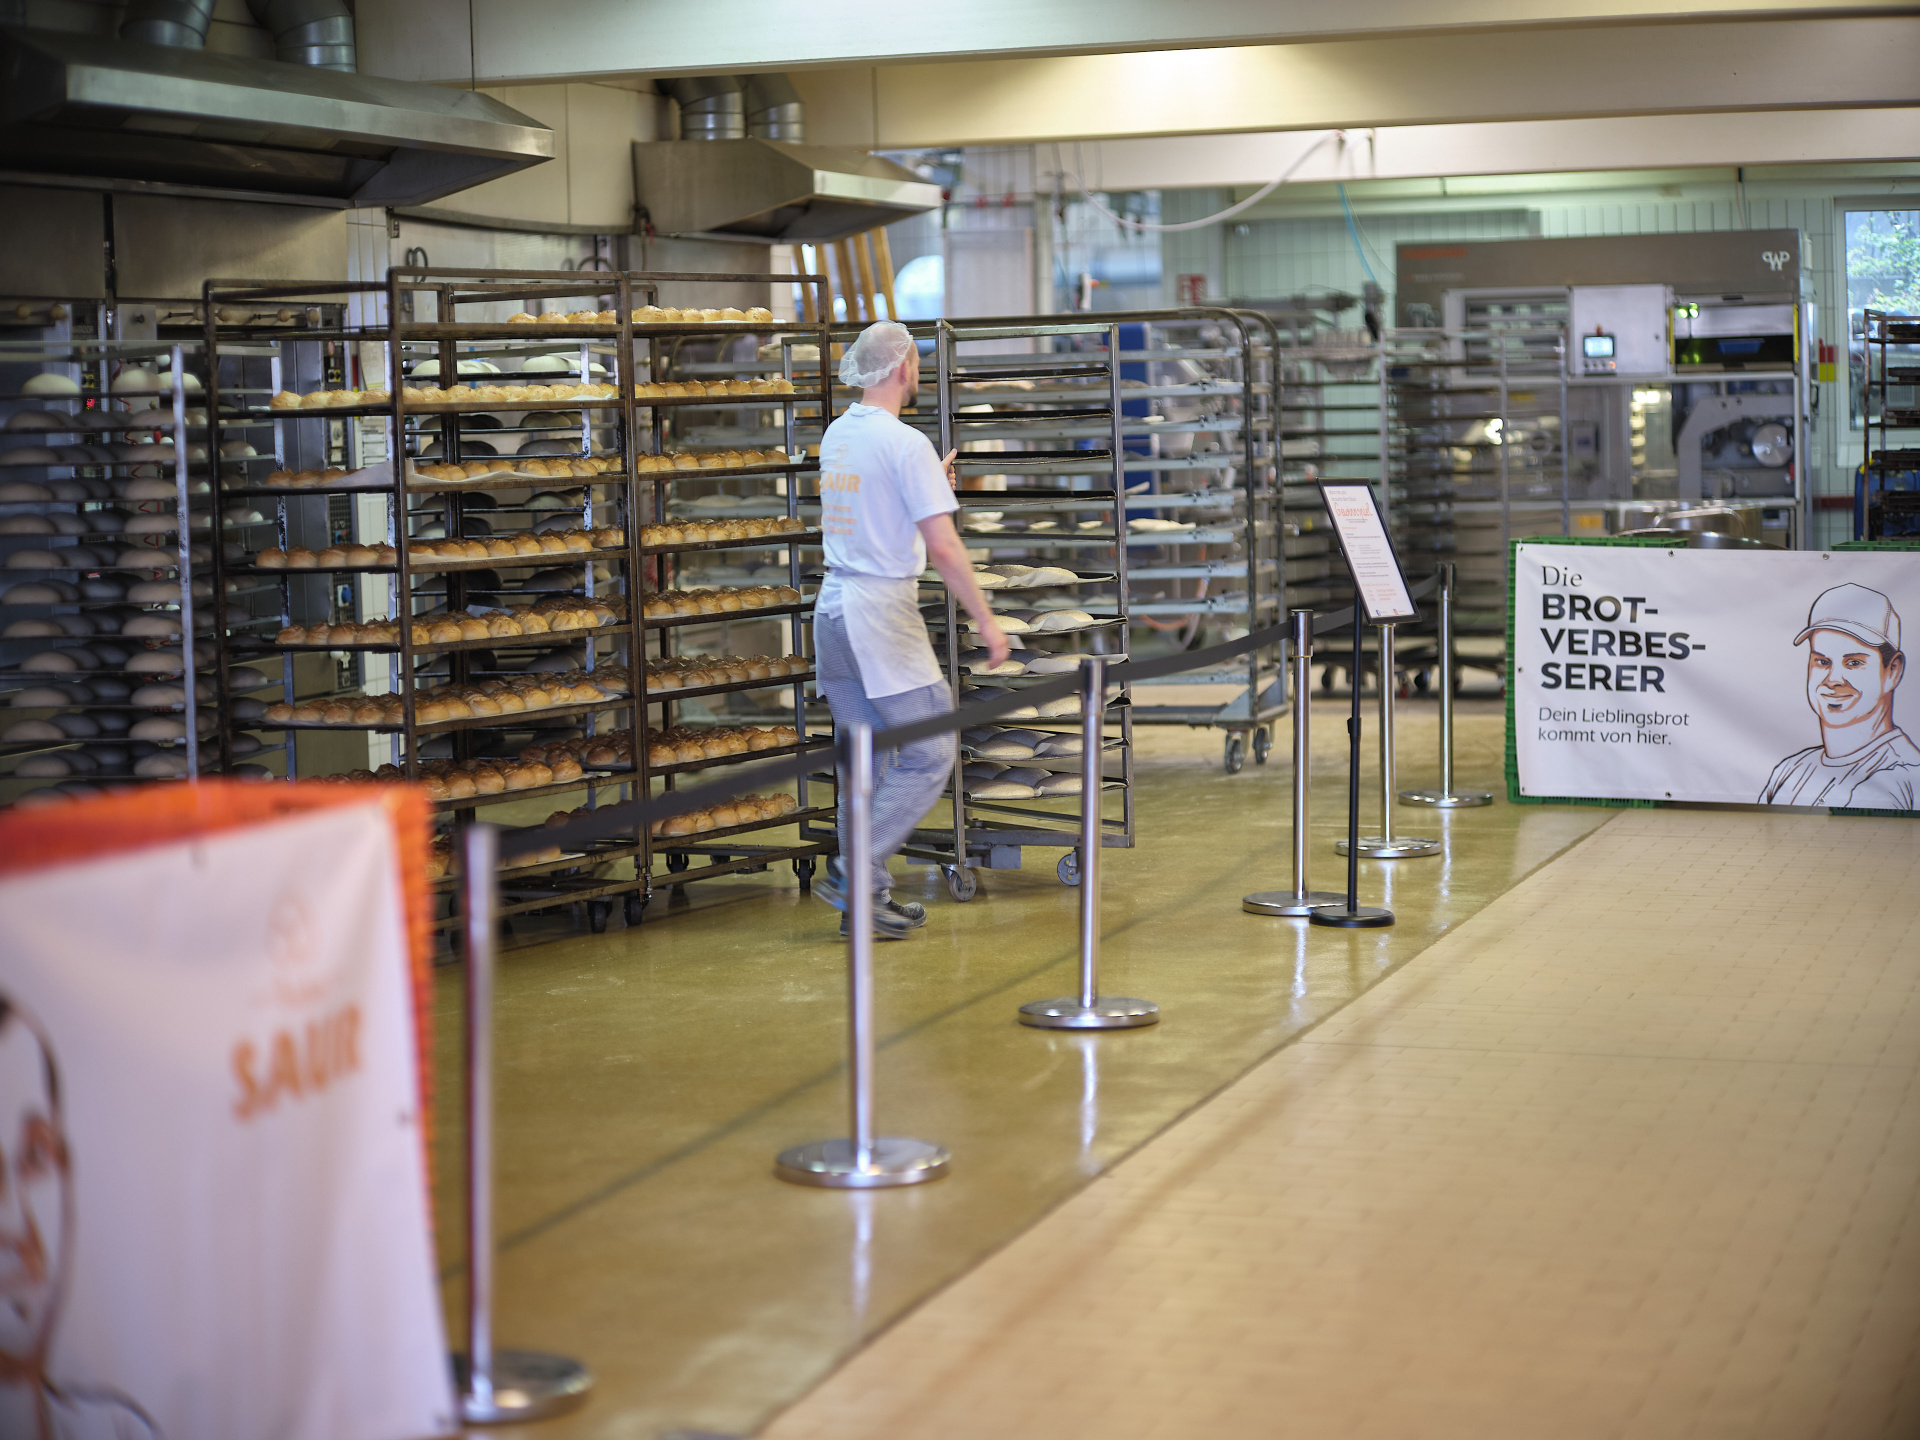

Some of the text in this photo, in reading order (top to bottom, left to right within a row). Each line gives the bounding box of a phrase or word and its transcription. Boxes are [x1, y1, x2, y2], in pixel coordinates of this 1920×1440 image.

[1541, 566, 1583, 587] Die
[1542, 594, 1659, 623] BROT-
[1540, 627, 1706, 660] VERBES-
[1541, 662, 1666, 693] SERER
[1539, 707, 1690, 729] Dein Lieblingsbrot
[1538, 727, 1672, 745] kommt von hier.
[230, 1003, 363, 1124] SAUR
